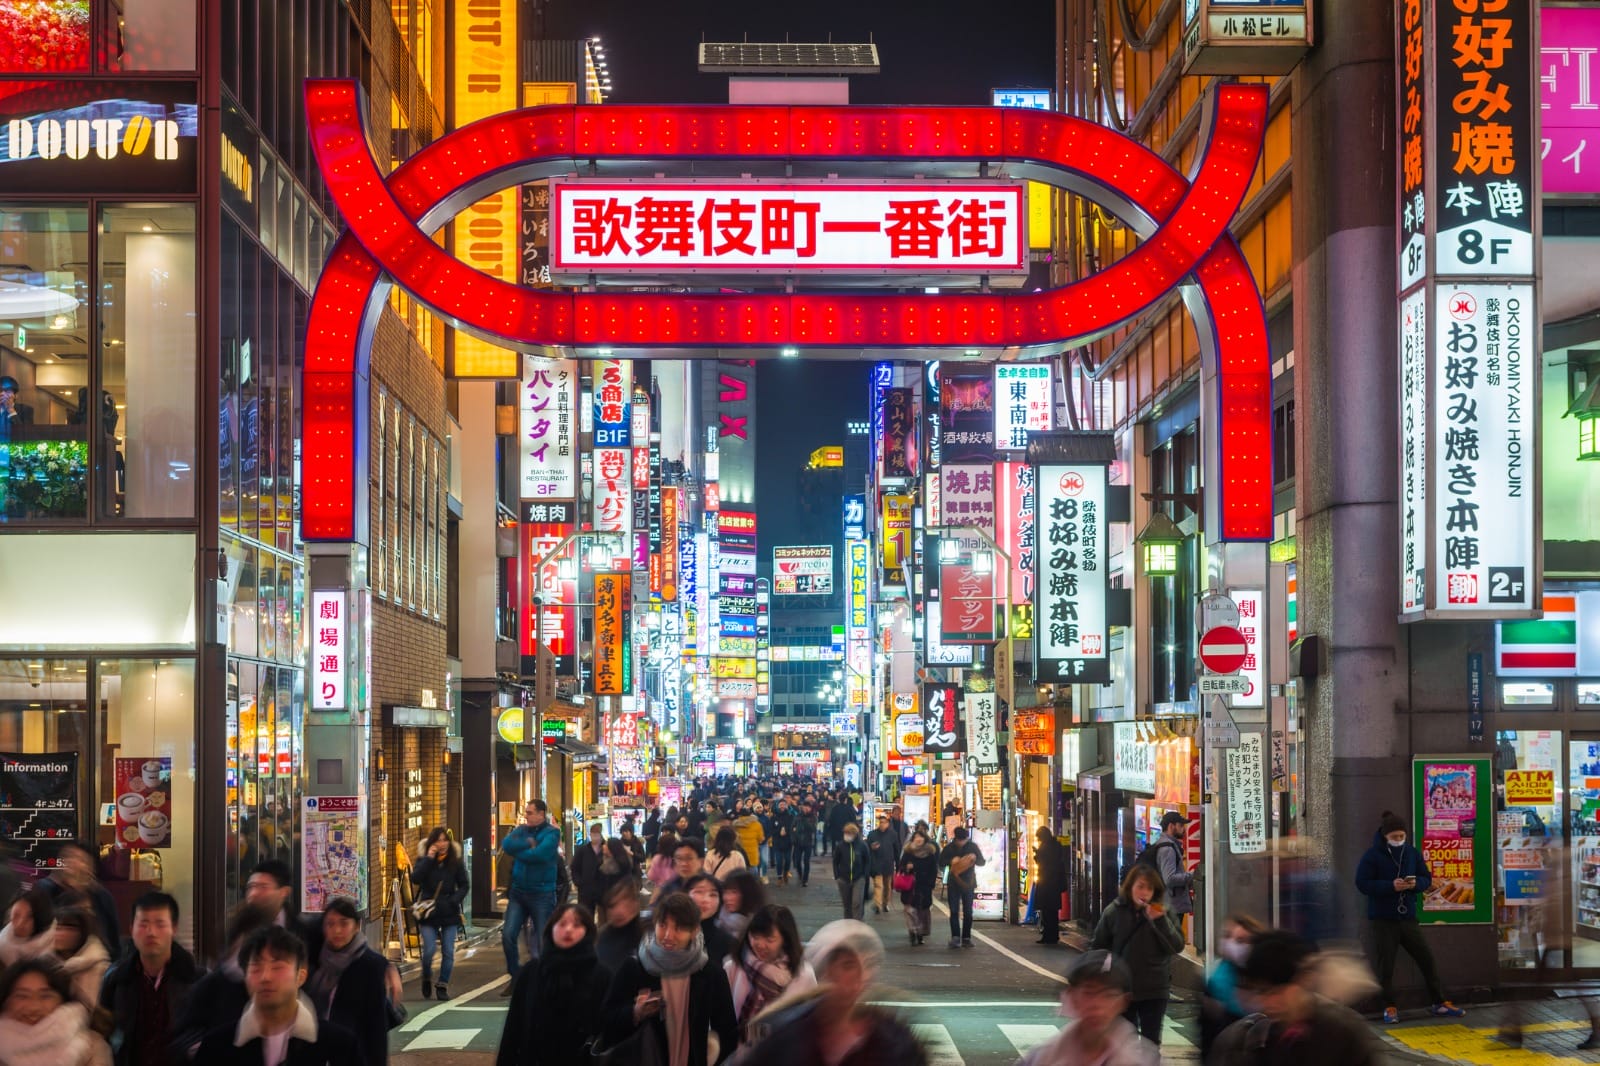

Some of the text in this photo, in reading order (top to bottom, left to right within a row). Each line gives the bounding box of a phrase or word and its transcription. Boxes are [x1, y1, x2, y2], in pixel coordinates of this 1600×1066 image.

[1223, 17, 1290, 36] 小松ビル
[1452, 0, 1516, 175] 好み焼
[8, 115, 179, 160] DOUTOR
[1445, 179, 1524, 218] 本陣
[572, 197, 1007, 259] 歌舞伎町一番街
[1456, 228, 1513, 265] 8F
[1408, 242, 1423, 277] 8F
[1486, 297, 1501, 387] 歌舞伎町名物
[998, 367, 1049, 378] 全卓全自動
[601, 360, 623, 423] ろ商店
[1507, 298, 1522, 498] OKONOMIYAKI HONJIN
[527, 369, 554, 463] バンタイ
[558, 370, 569, 457] タイ国料理専門店
[1009, 380, 1028, 448] 東南荘
[1030, 401, 1039, 426] 専門
[596, 429, 628, 443] B1F
[943, 431, 993, 444] 酒場牧場
[1444, 320, 1480, 571] お好み焼き本陣
[537, 484, 558, 495] 3F
[529, 504, 566, 522] 焼肉
[1082, 500, 1097, 572] 歌舞伎町名物
[1049, 497, 1080, 648] お好み焼本陣
[1491, 571, 1524, 597] 2F
[319, 600, 339, 700] 劇場通り
[1202, 679, 1246, 691] 自転車を除く
[1471, 720, 1482, 729] 17
[1241, 742, 1254, 833] 防犯カメラ作動中
[1251, 737, 1263, 838] みなさまの安全を守ります
[1506, 771, 1553, 782] ATM
[34, 799, 47, 808] 4F
[34, 829, 47, 837] 3F
[1424, 839, 1460, 849] フランク
[35, 859, 47, 867] 2F
